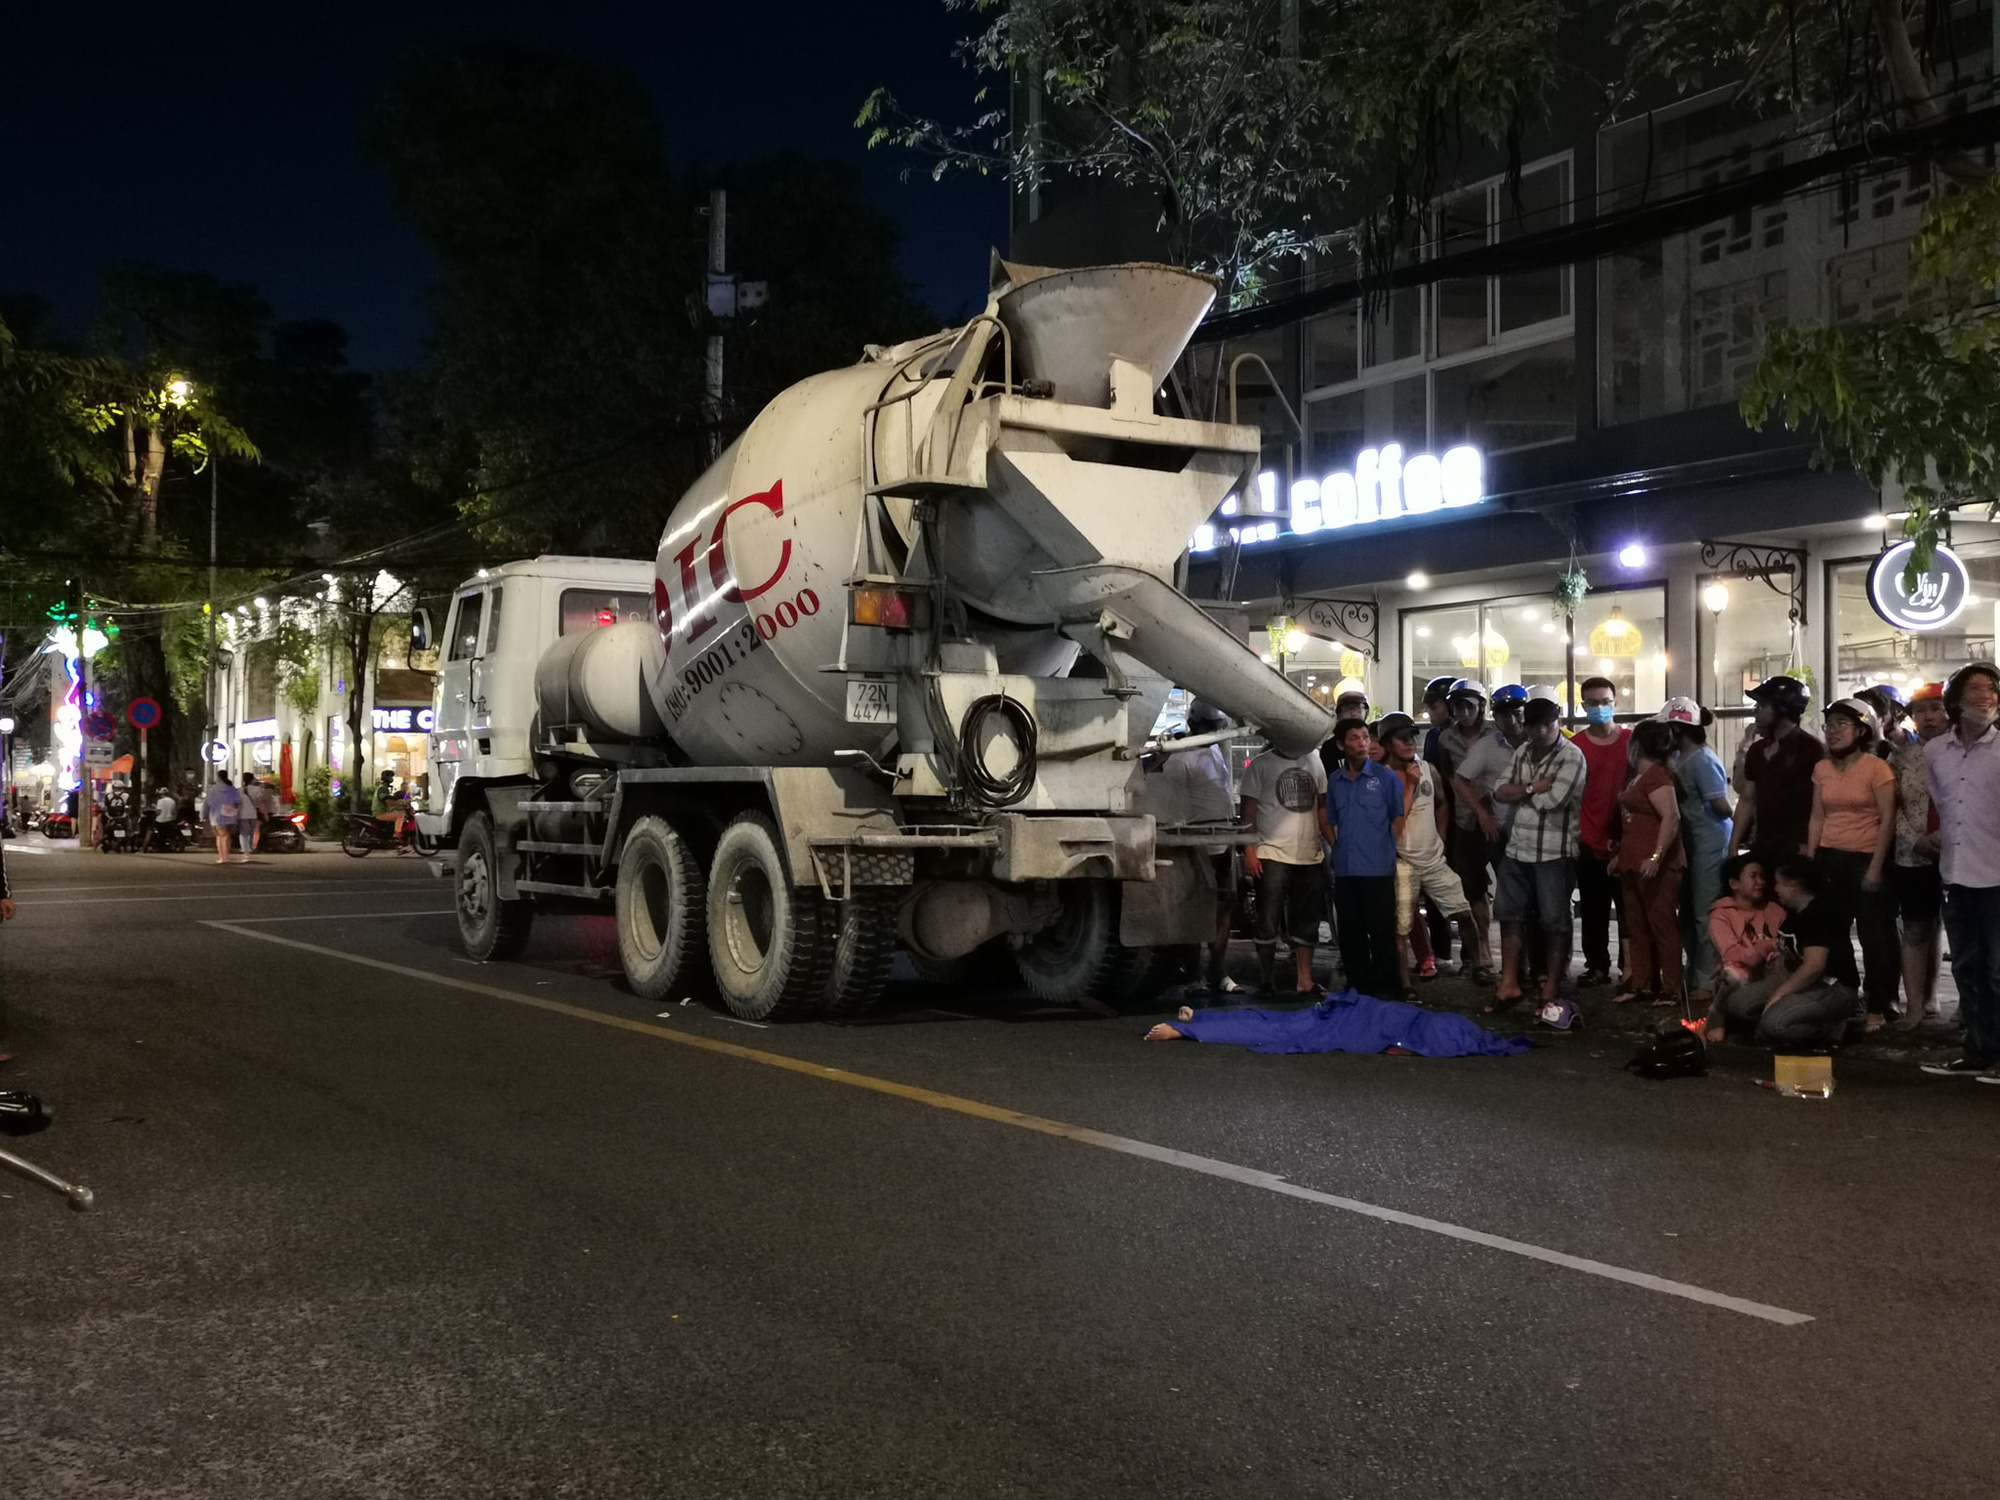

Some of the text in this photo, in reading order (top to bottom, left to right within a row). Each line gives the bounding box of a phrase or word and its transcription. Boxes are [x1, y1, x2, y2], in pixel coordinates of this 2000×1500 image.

[1290, 443, 1482, 534] coffee
[857, 684, 888, 703] 72N
[370, 709, 411, 729] THE
[852, 703, 891, 721] 4471
